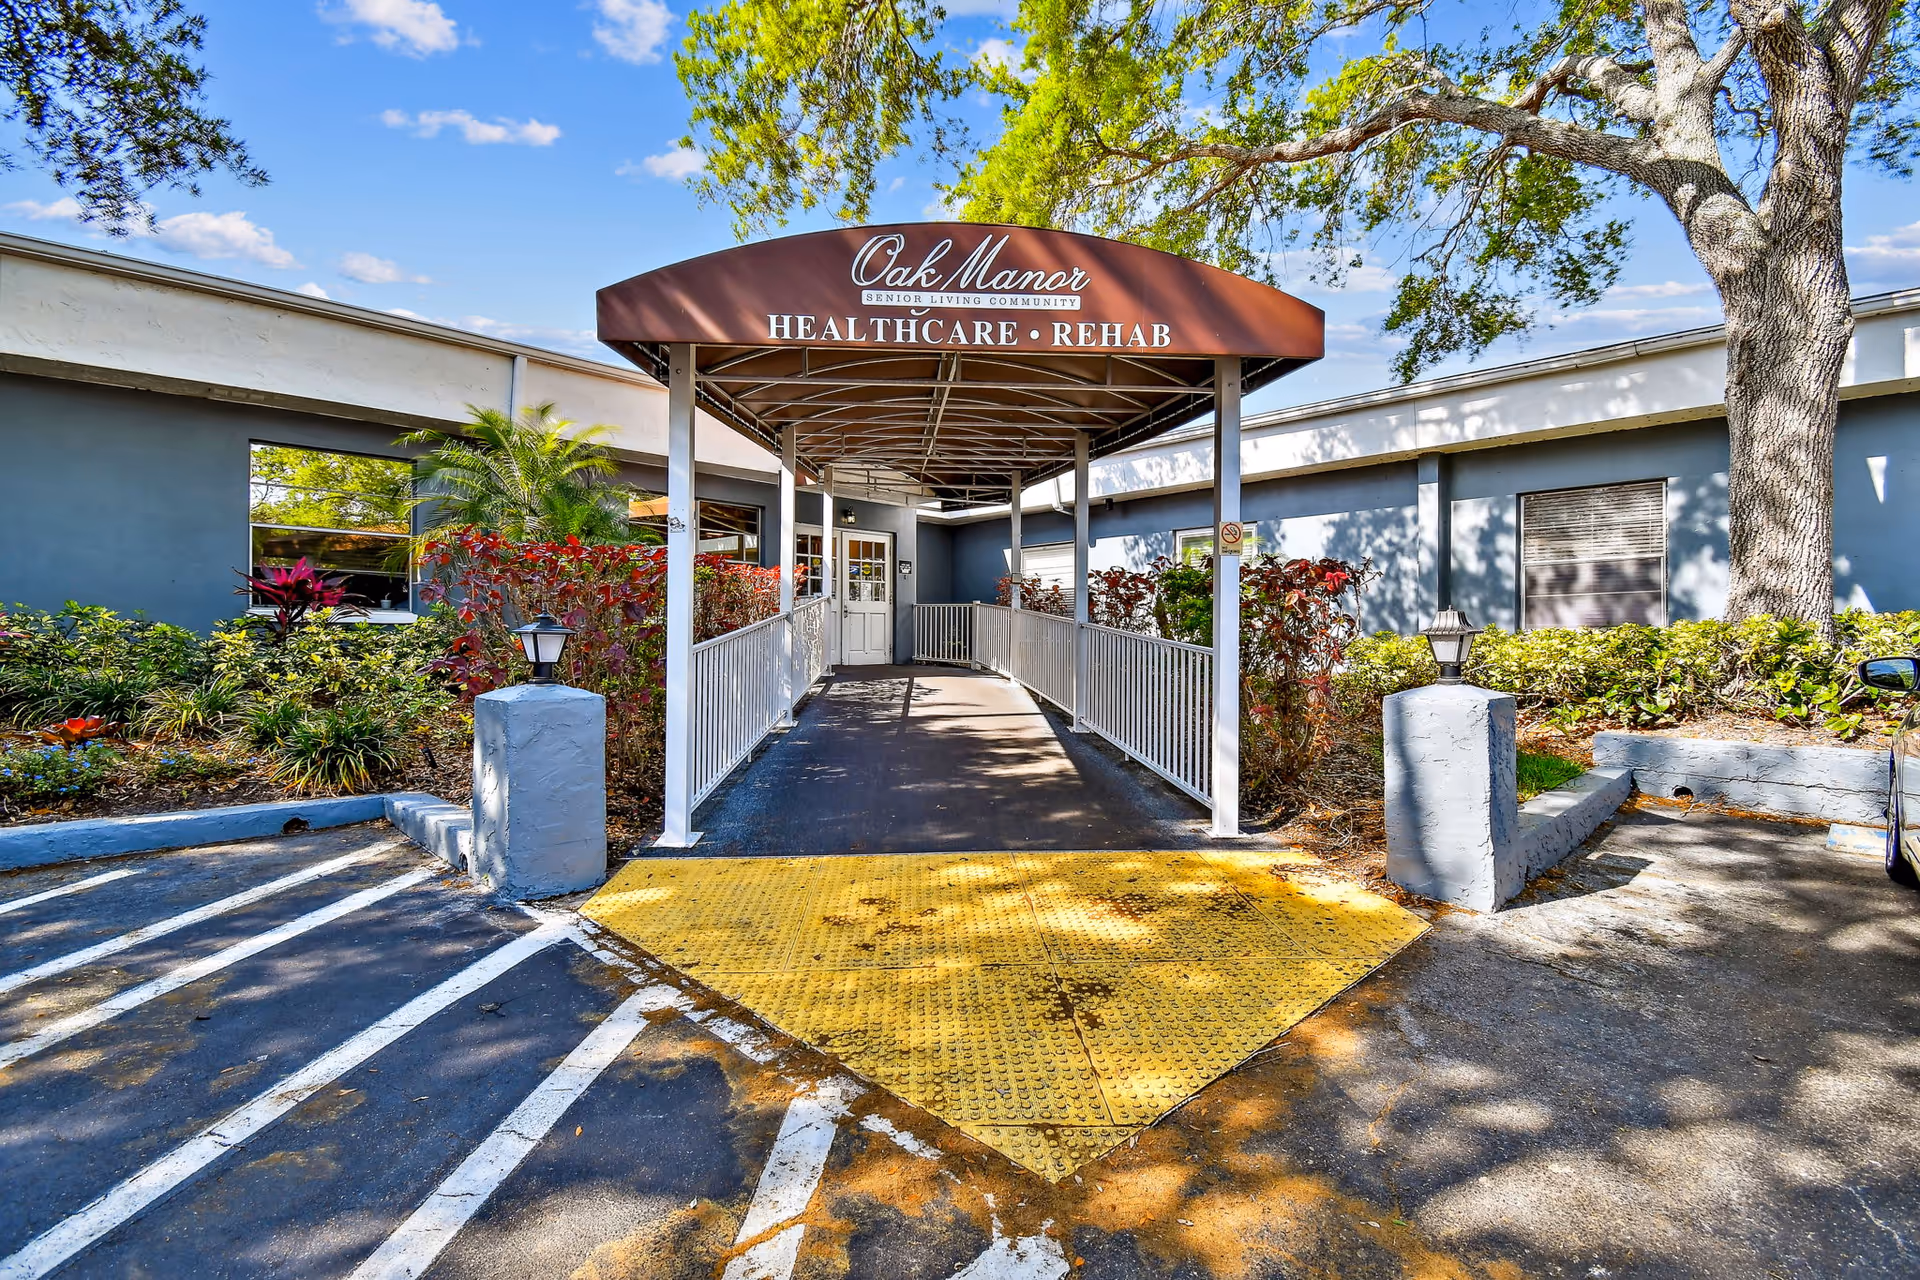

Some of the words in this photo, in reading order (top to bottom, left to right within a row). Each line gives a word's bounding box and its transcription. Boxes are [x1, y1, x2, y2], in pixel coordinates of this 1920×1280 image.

[851, 233, 953, 288] Oak
[939, 233, 1091, 292] Manor
[866, 293, 922, 303] SENIOR
[930, 295, 981, 305] LIVING
[989, 296, 1077, 307] COMMUNITY
[767, 314, 1019, 346] HEALTHCARE
[1050, 321, 1172, 348] REHAB
